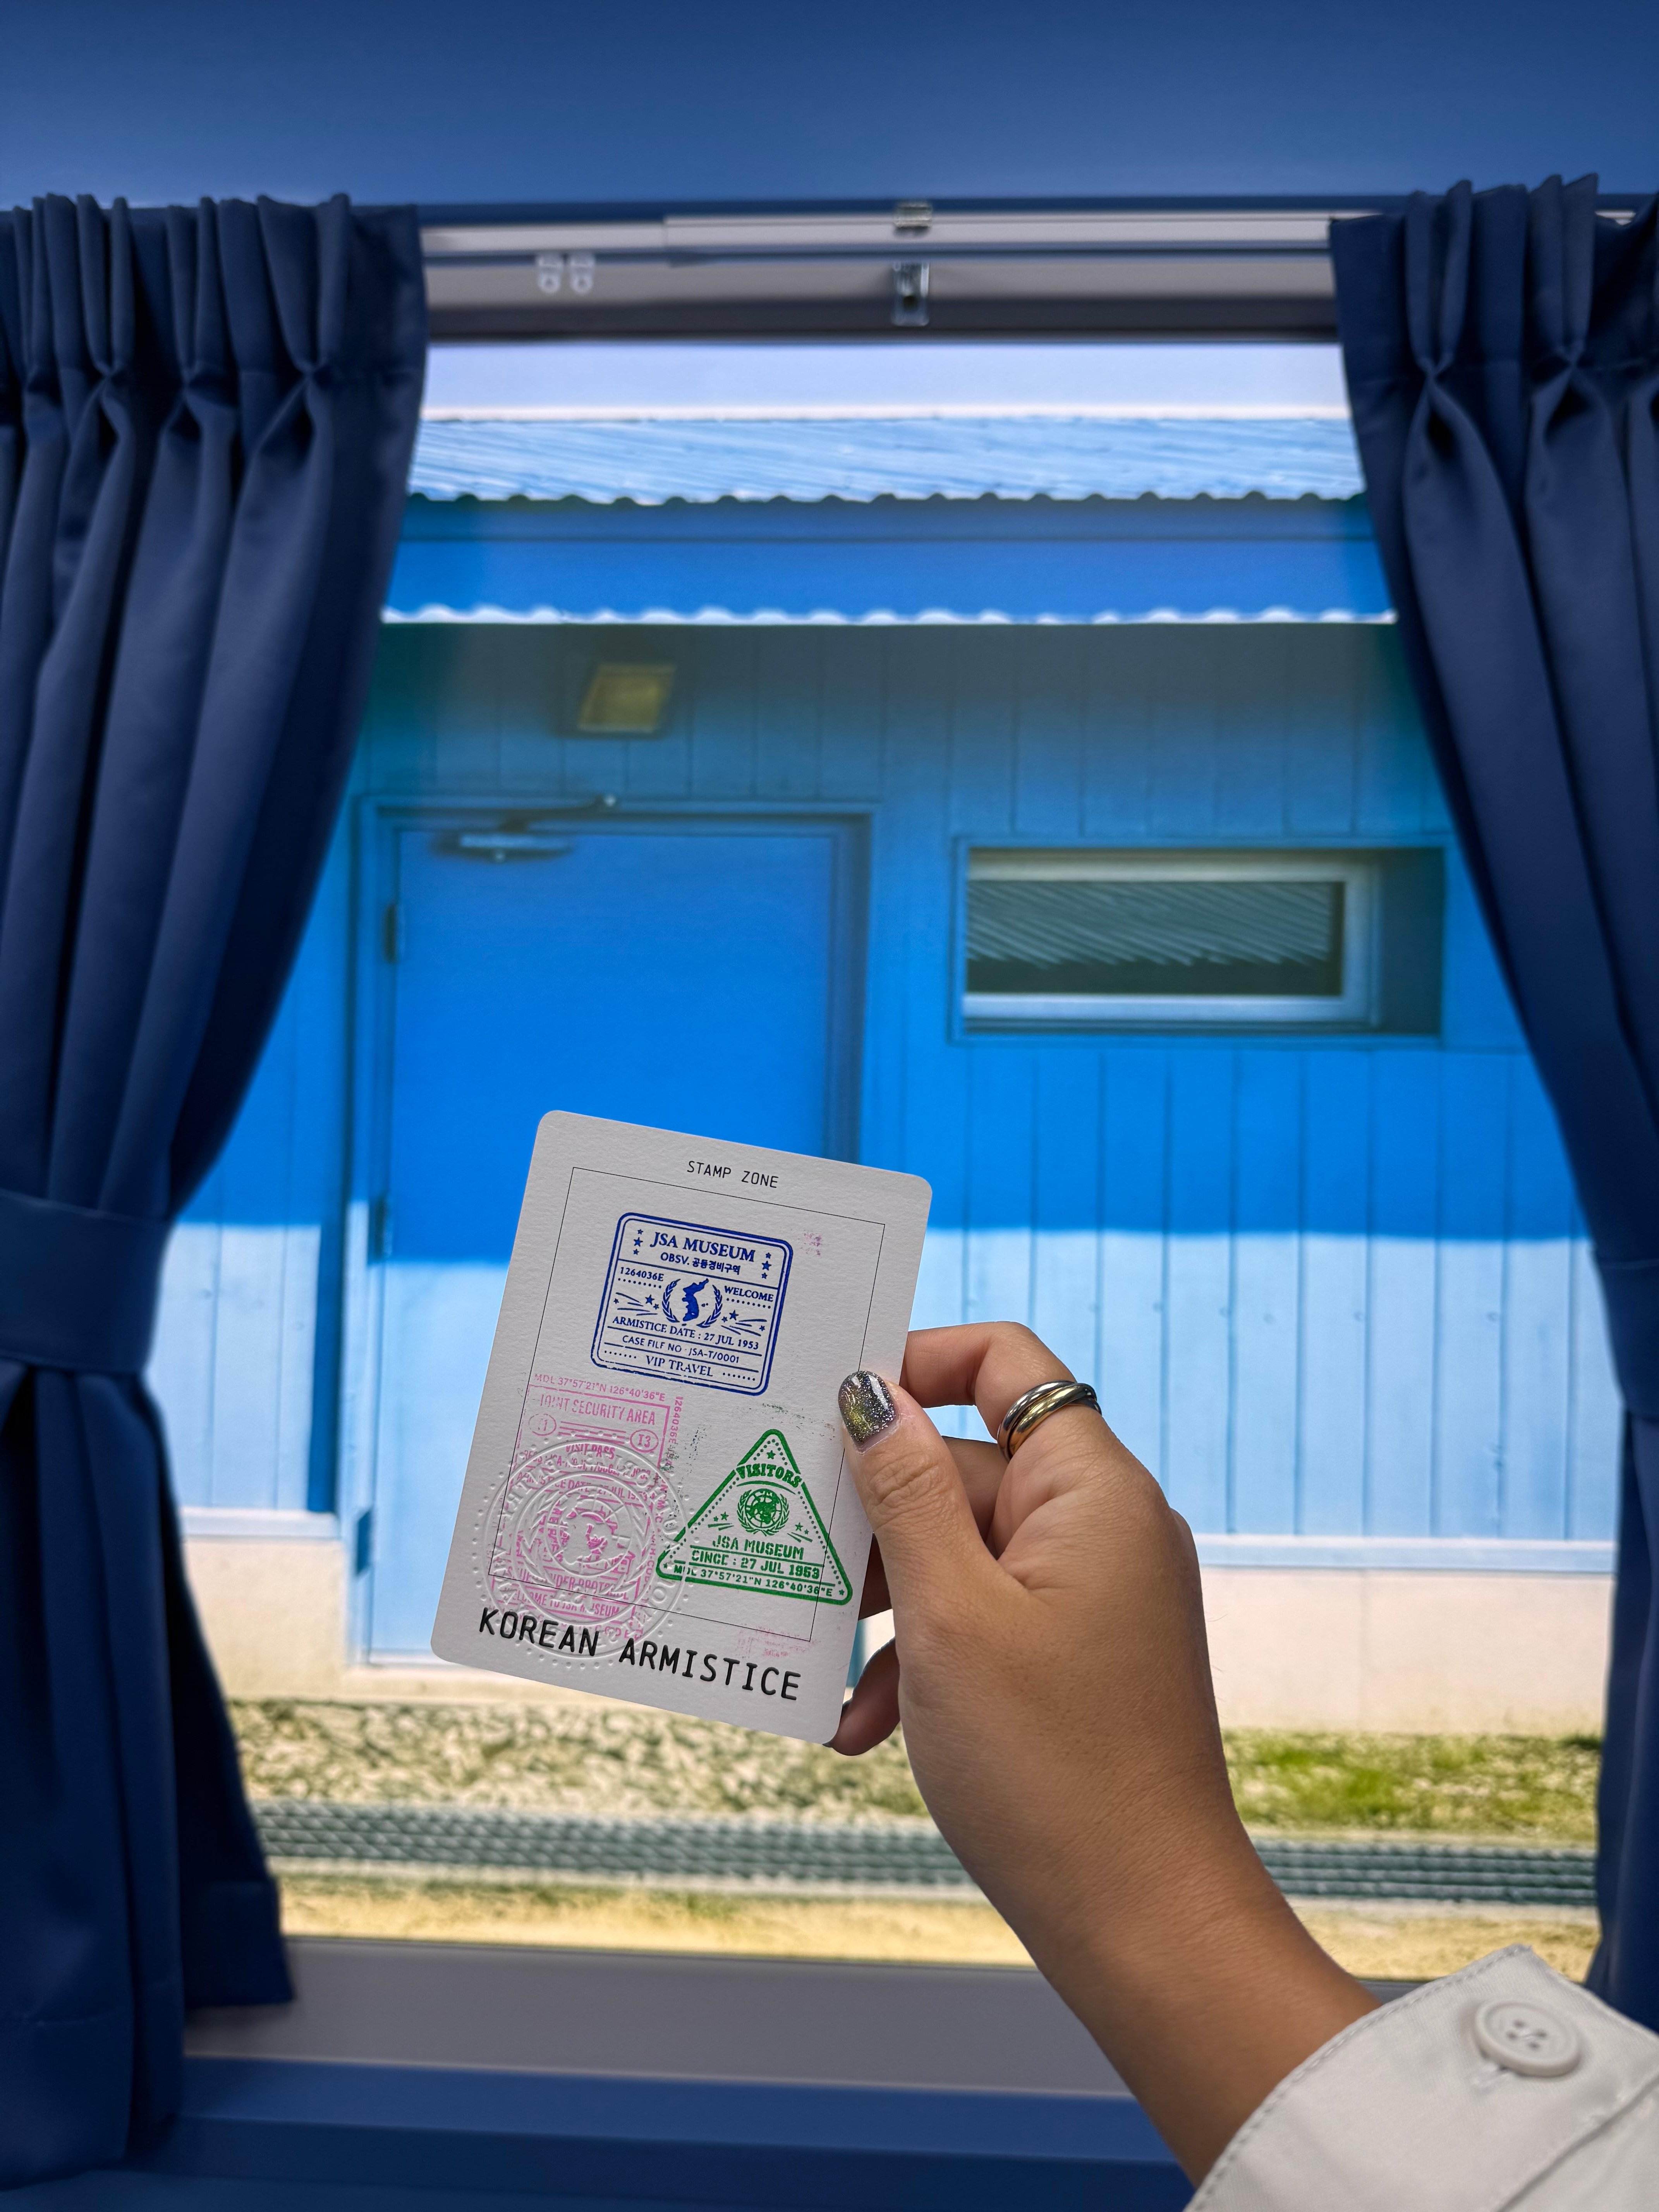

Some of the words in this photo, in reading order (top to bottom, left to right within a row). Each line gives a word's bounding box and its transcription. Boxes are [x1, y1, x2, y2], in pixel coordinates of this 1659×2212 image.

[687, 1161, 731, 1178] STAMP
[742, 1171, 778, 1188] ZONE
[650, 1232, 678, 1248] JSA
[682, 1237, 756, 1262] MUSEUM
[661, 1252, 689, 1265] OBSV.
[621, 1267, 664, 1281] 1264036E
[725, 1286, 774, 1302] WELCOME
[613, 1316, 667, 1331] ARMISTICE
[670, 1324, 696, 1338] DATE
[704, 1333, 715, 1341] 27
[715, 1335, 734, 1345] JUL
[738, 1340, 758, 1350] 1953
[623, 1335, 645, 1346] CASE
[689, 1348, 739, 1363] JSA-T/0001
[646, 1355, 665, 1367] VIP
[669, 1360, 713, 1376] TRAVEL
[534, 1374, 556, 1385] MDL
[572, 1398, 625, 1420] SECURITY
[626, 1408, 655, 1425] AREA
[737, 1463, 802, 1487] VISITORS
[712, 1536, 738, 1550] JSA
[744, 1540, 804, 1562] MUSEUM
[740, 1558, 757, 1569] 27
[761, 1561, 784, 1574] JUL
[789, 1565, 819, 1579] 1953
[479, 1607, 599, 1656] KOREAN
[619, 1638, 800, 1700] ARMISTICE
